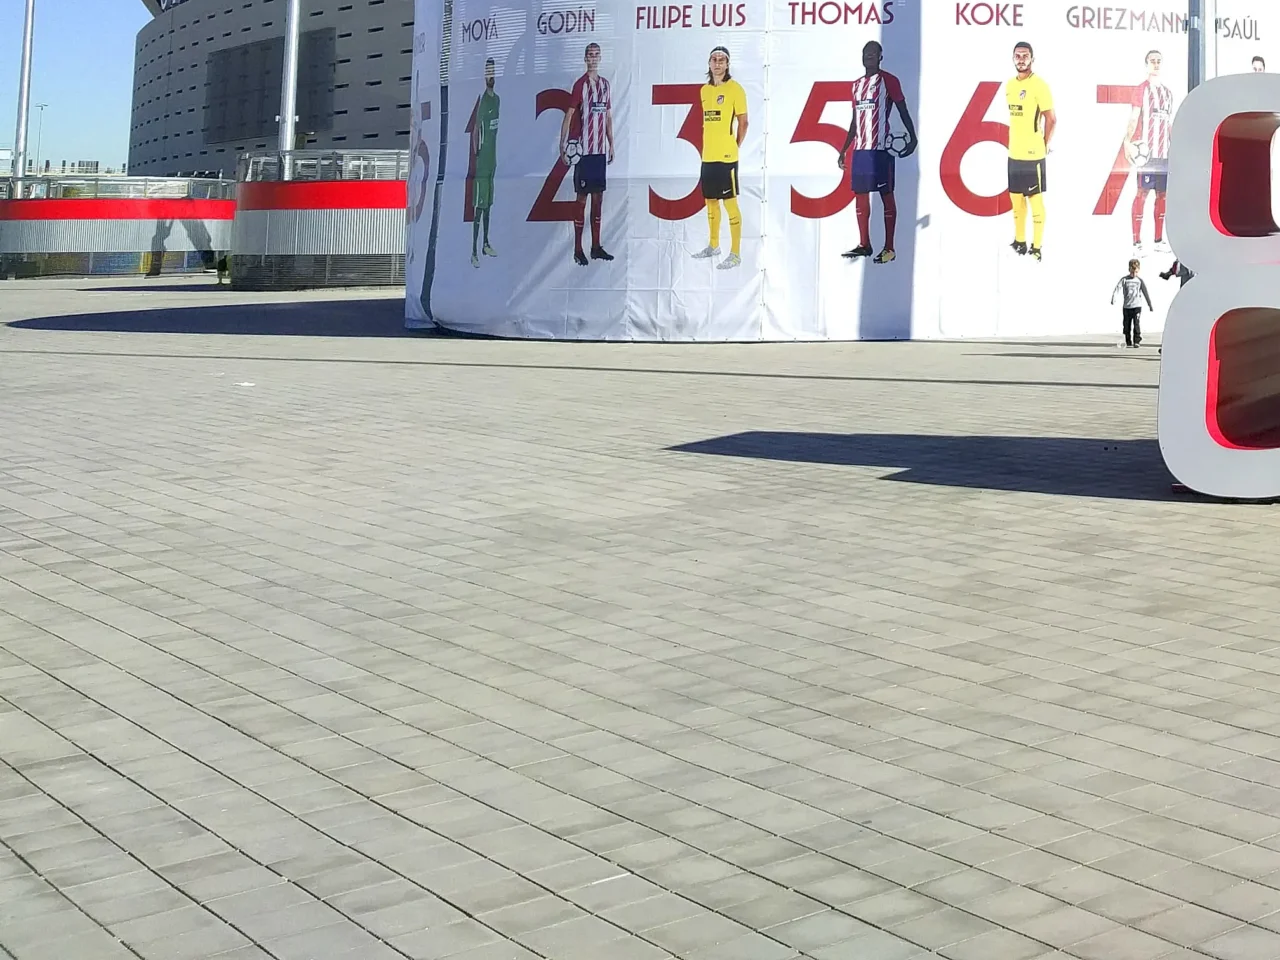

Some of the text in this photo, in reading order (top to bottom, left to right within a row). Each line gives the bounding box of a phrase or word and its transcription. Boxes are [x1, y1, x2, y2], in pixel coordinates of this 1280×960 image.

[461, 13, 500, 43] MOYÁ
[537, 4, 596, 34] GODÍN
[635, 2, 747, 29] FILIPE LUIS
[788, 0, 895, 26] THOMAS
[955, 2, 1024, 27] KOKE
[1065, 5, 1188, 34] GRIEZMANN
[1222, 14, 1261, 41] SAÚL
[526, 88, 587, 222] 2
[648, 83, 707, 221] 3
[789, 80, 858, 220] 5
[939, 81, 1013, 218] 6
[1092, 85, 1140, 215] 7
